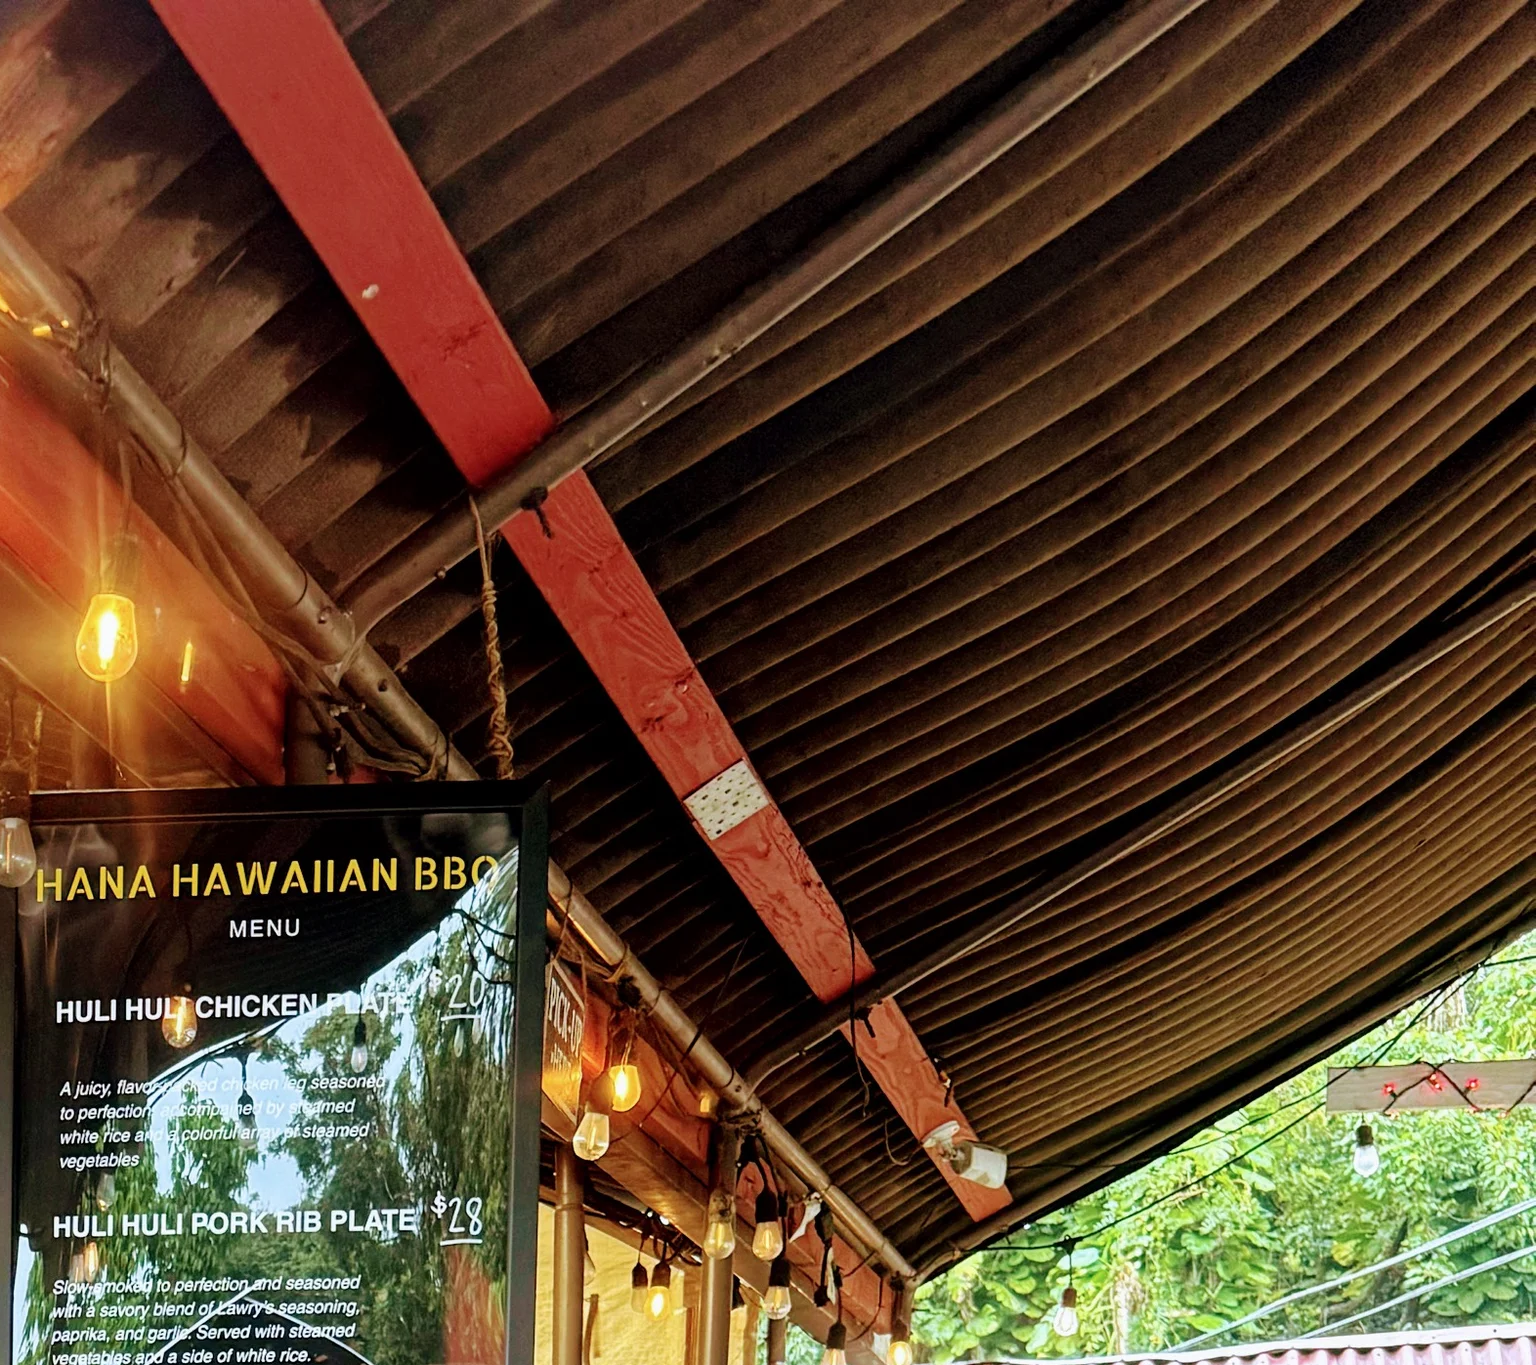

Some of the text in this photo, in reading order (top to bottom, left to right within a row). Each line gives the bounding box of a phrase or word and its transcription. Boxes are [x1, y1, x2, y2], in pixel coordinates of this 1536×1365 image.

[36, 864, 156, 902] HANA
[172, 857, 397, 897] HAWAIIAN
[229, 917, 300, 938] MENU
[55, 999, 117, 1024] HULI
[195, 992, 317, 1019] CHICKEN
[327, 991, 411, 1015] PLATE
[429, 966, 486, 1010] $20
[548, 977, 583, 1058] PICK-UP
[59, 1081, 71, 1097] A
[73, 1081, 112, 1099] juicy,
[221, 1076, 282, 1091] chicken
[283, 1075, 307, 1091] leg
[310, 1074, 386, 1090] seasoned
[59, 1106, 75, 1120] to
[266, 1101, 286, 1119] by
[289, 1098, 356, 1115] steamed
[59, 1128, 99, 1144] white
[103, 1128, 131, 1143] rice
[134, 1128, 163, 1142] and
[181, 1125, 238, 1141] colorful
[240, 1127, 281, 1142] array
[283, 1124, 300, 1139] of
[302, 1122, 370, 1138] steamed
[59, 1152, 140, 1171] vegetables
[53, 1190, 483, 1238] HULI HULI PORK RIB PLATE $28
[53, 1274, 362, 1295] Slow-smoked to perfection and seasoned
[53, 1299, 360, 1322] with a savory blend of Lawry's seasoning,
[51, 1322, 356, 1345] paprika, and garlic. Served with steamed
[135, 1350, 164, 1365] and
[167, 1353, 177, 1364] a
[181, 1349, 213, 1364] side
[217, 1348, 233, 1363] of
[236, 1347, 276, 1363] white
[279, 1347, 312, 1363] rice.
